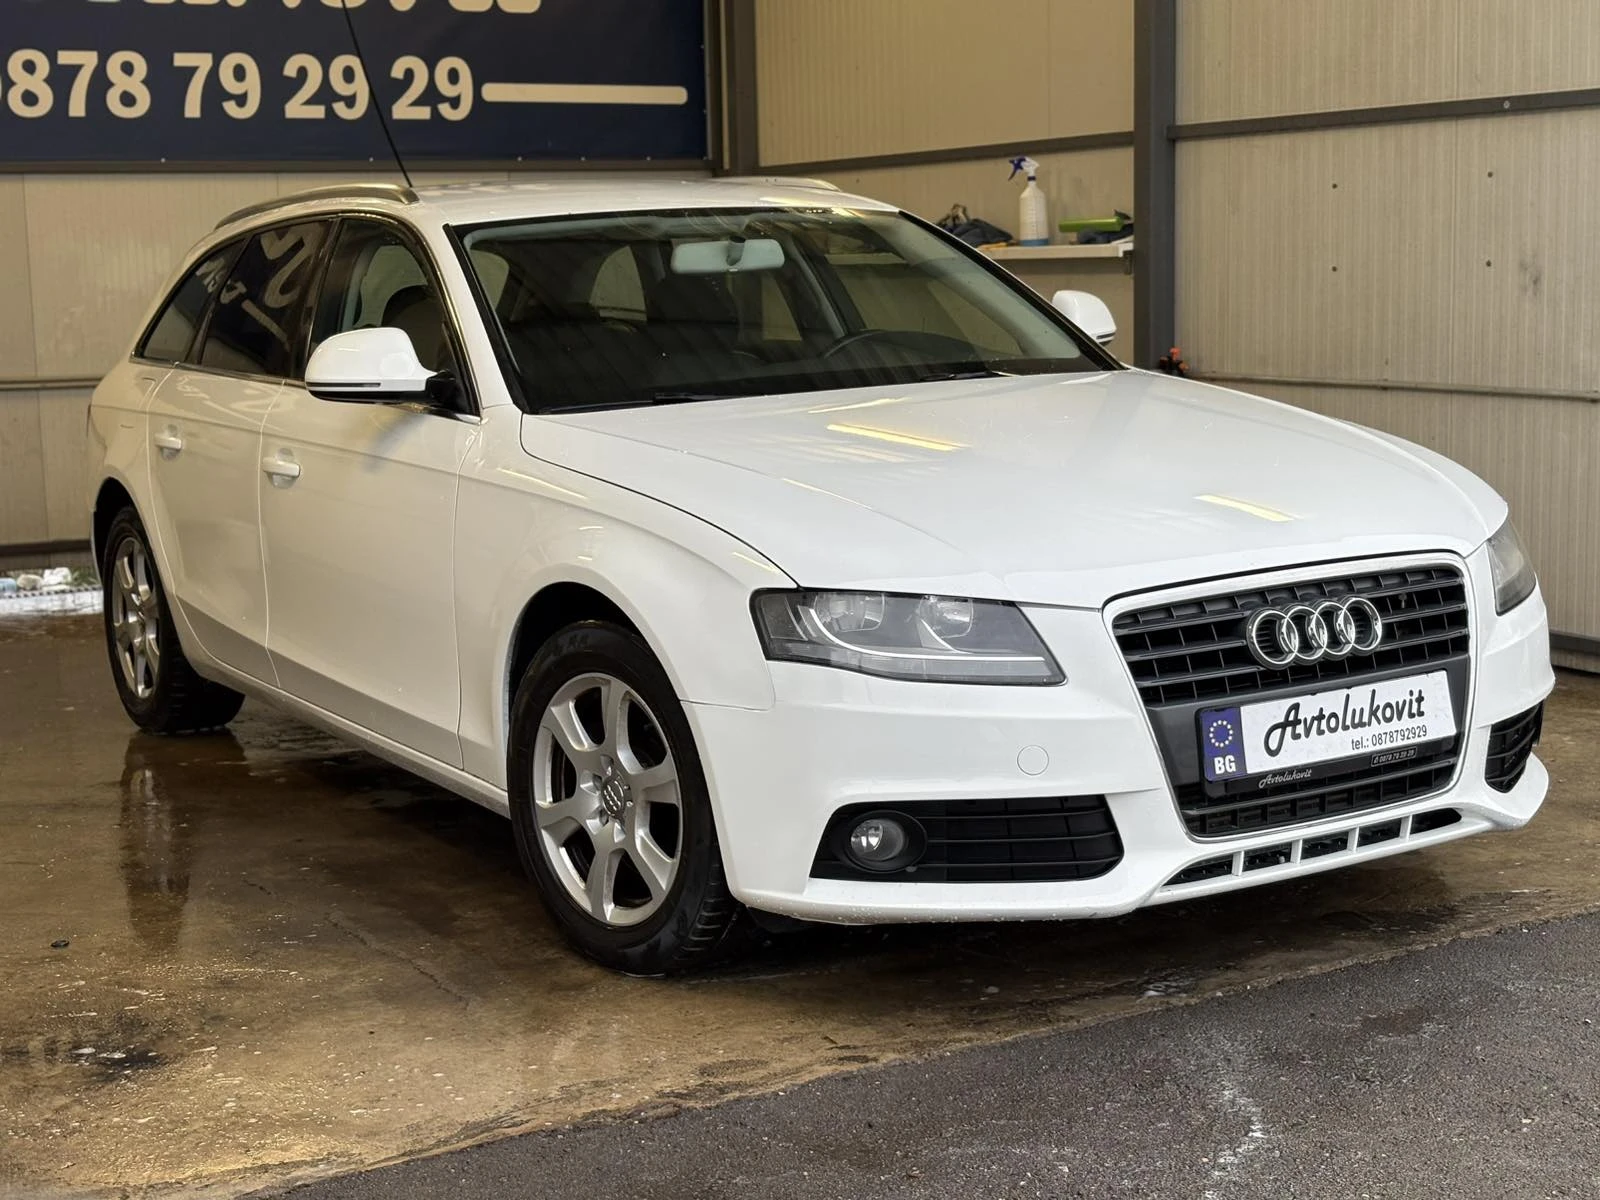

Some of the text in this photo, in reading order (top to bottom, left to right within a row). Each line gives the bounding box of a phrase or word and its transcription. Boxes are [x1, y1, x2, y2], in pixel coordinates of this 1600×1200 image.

[0, 48, 473, 121] 878 79 29 29
[1264, 689, 1425, 757] Avtolukovit
[1351, 724, 1427, 750] tel.: 0878792929
[1214, 756, 1236, 775] BG
[1258, 768, 1312, 789] Avtolukovit
